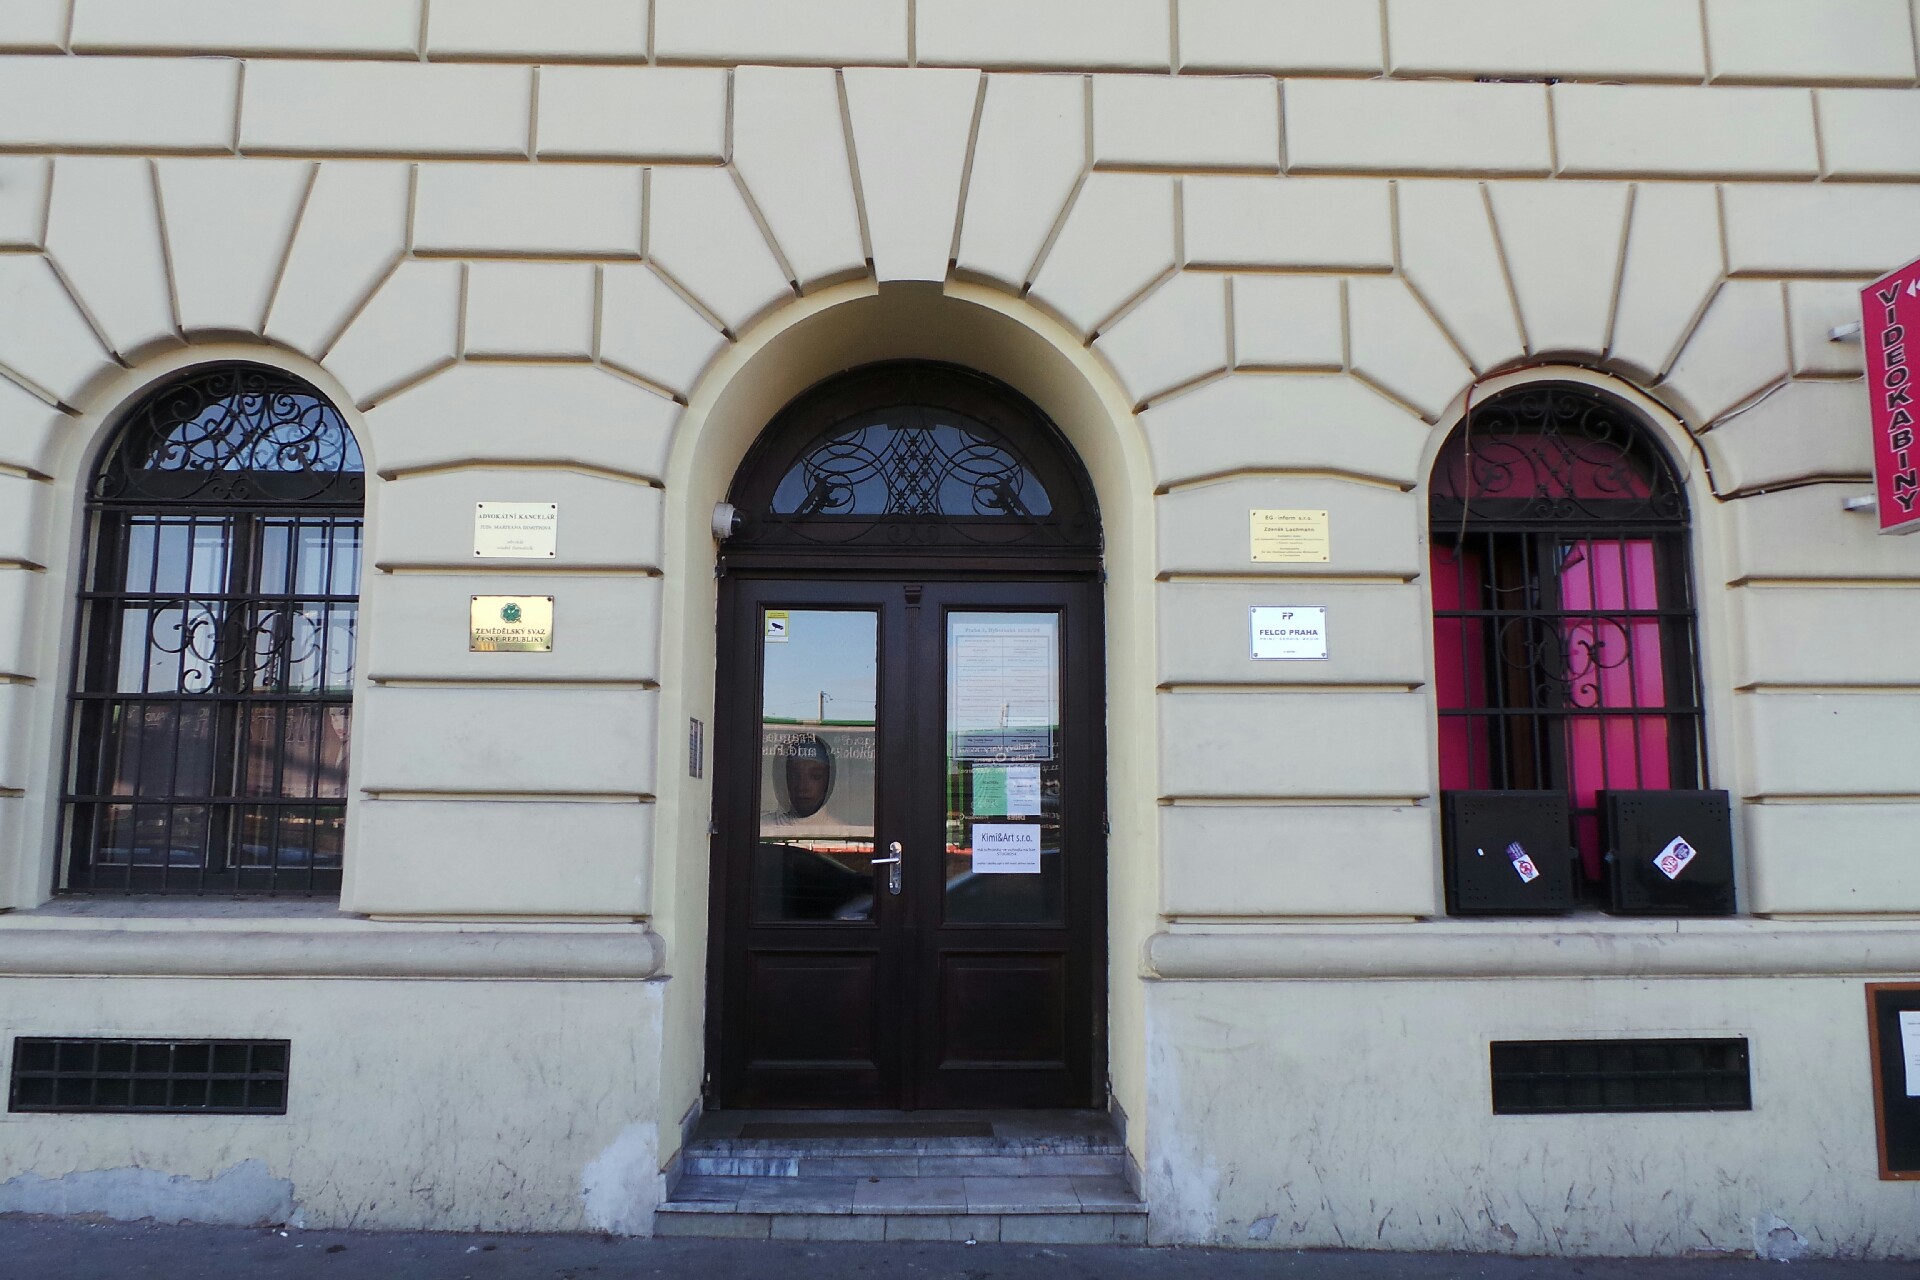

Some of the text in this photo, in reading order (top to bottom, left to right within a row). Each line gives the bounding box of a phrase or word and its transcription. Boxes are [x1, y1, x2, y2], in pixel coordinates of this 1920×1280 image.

[1876, 280, 1920, 513] VIDEOKABINY
[1282, 612, 1294, 620] FP
[475, 627, 526, 635] ZEMĚDĚLSKÝ
[476, 634, 500, 642] ČESKÉ
[981, 832, 1014, 842] Kimi&Art
